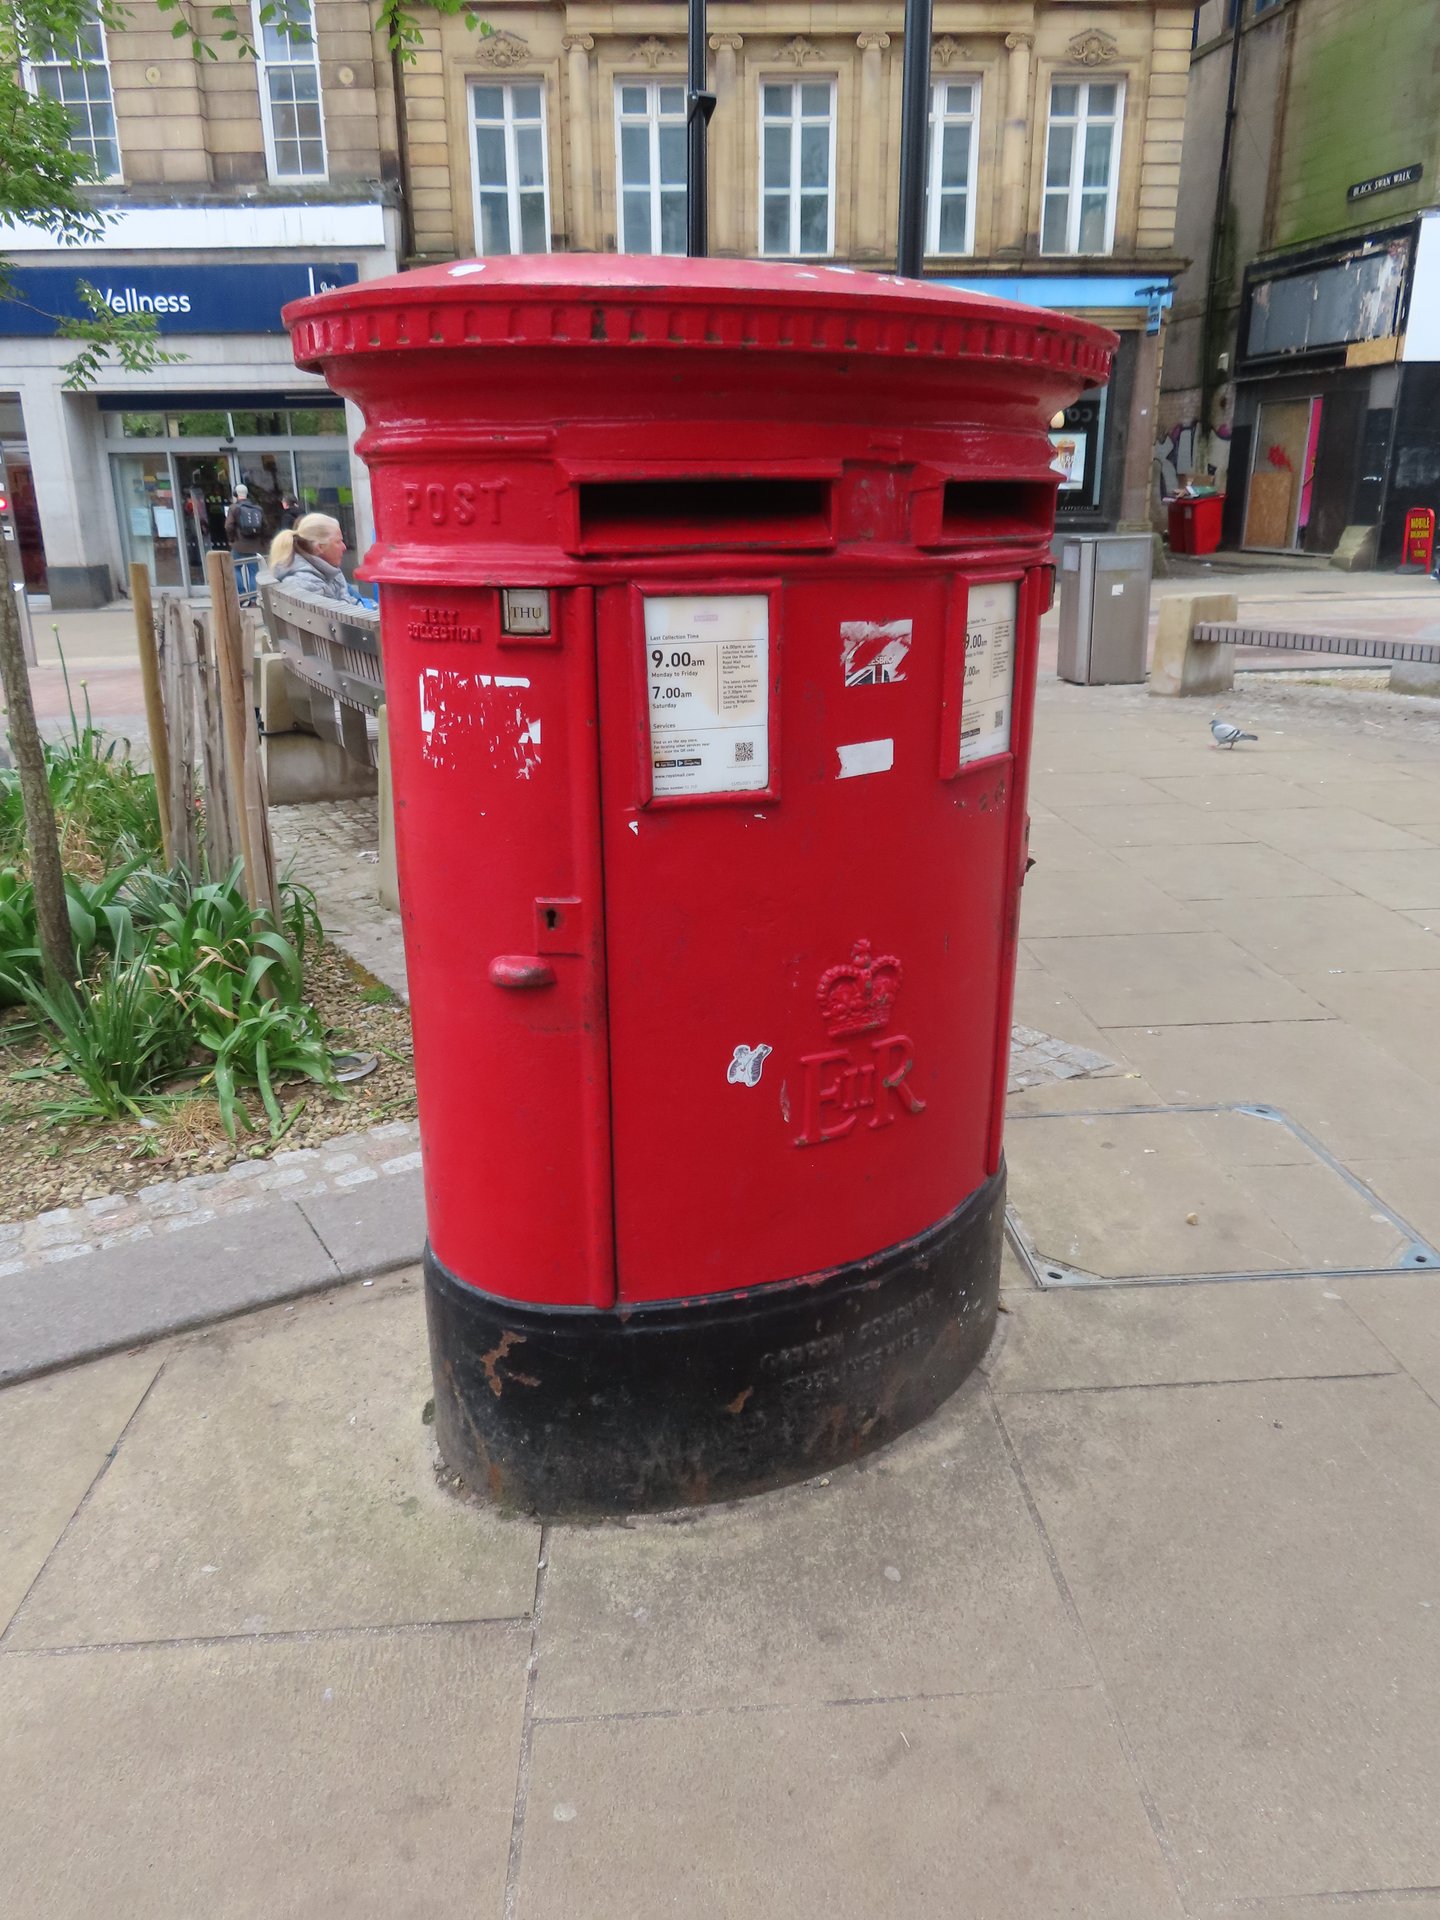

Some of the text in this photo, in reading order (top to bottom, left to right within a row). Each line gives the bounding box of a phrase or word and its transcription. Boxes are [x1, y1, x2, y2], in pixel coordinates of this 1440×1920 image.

[1352, 169, 1412, 196] BLACK SWAN WALK
[402, 480, 510, 526] POST
[1410, 517, 1430, 528] MOBILE
[510, 606, 542, 620] THU
[407, 621, 483, 643] COLLECTION
[652, 650, 705, 668] 9.00am
[652, 686, 692, 700] 7.00am
